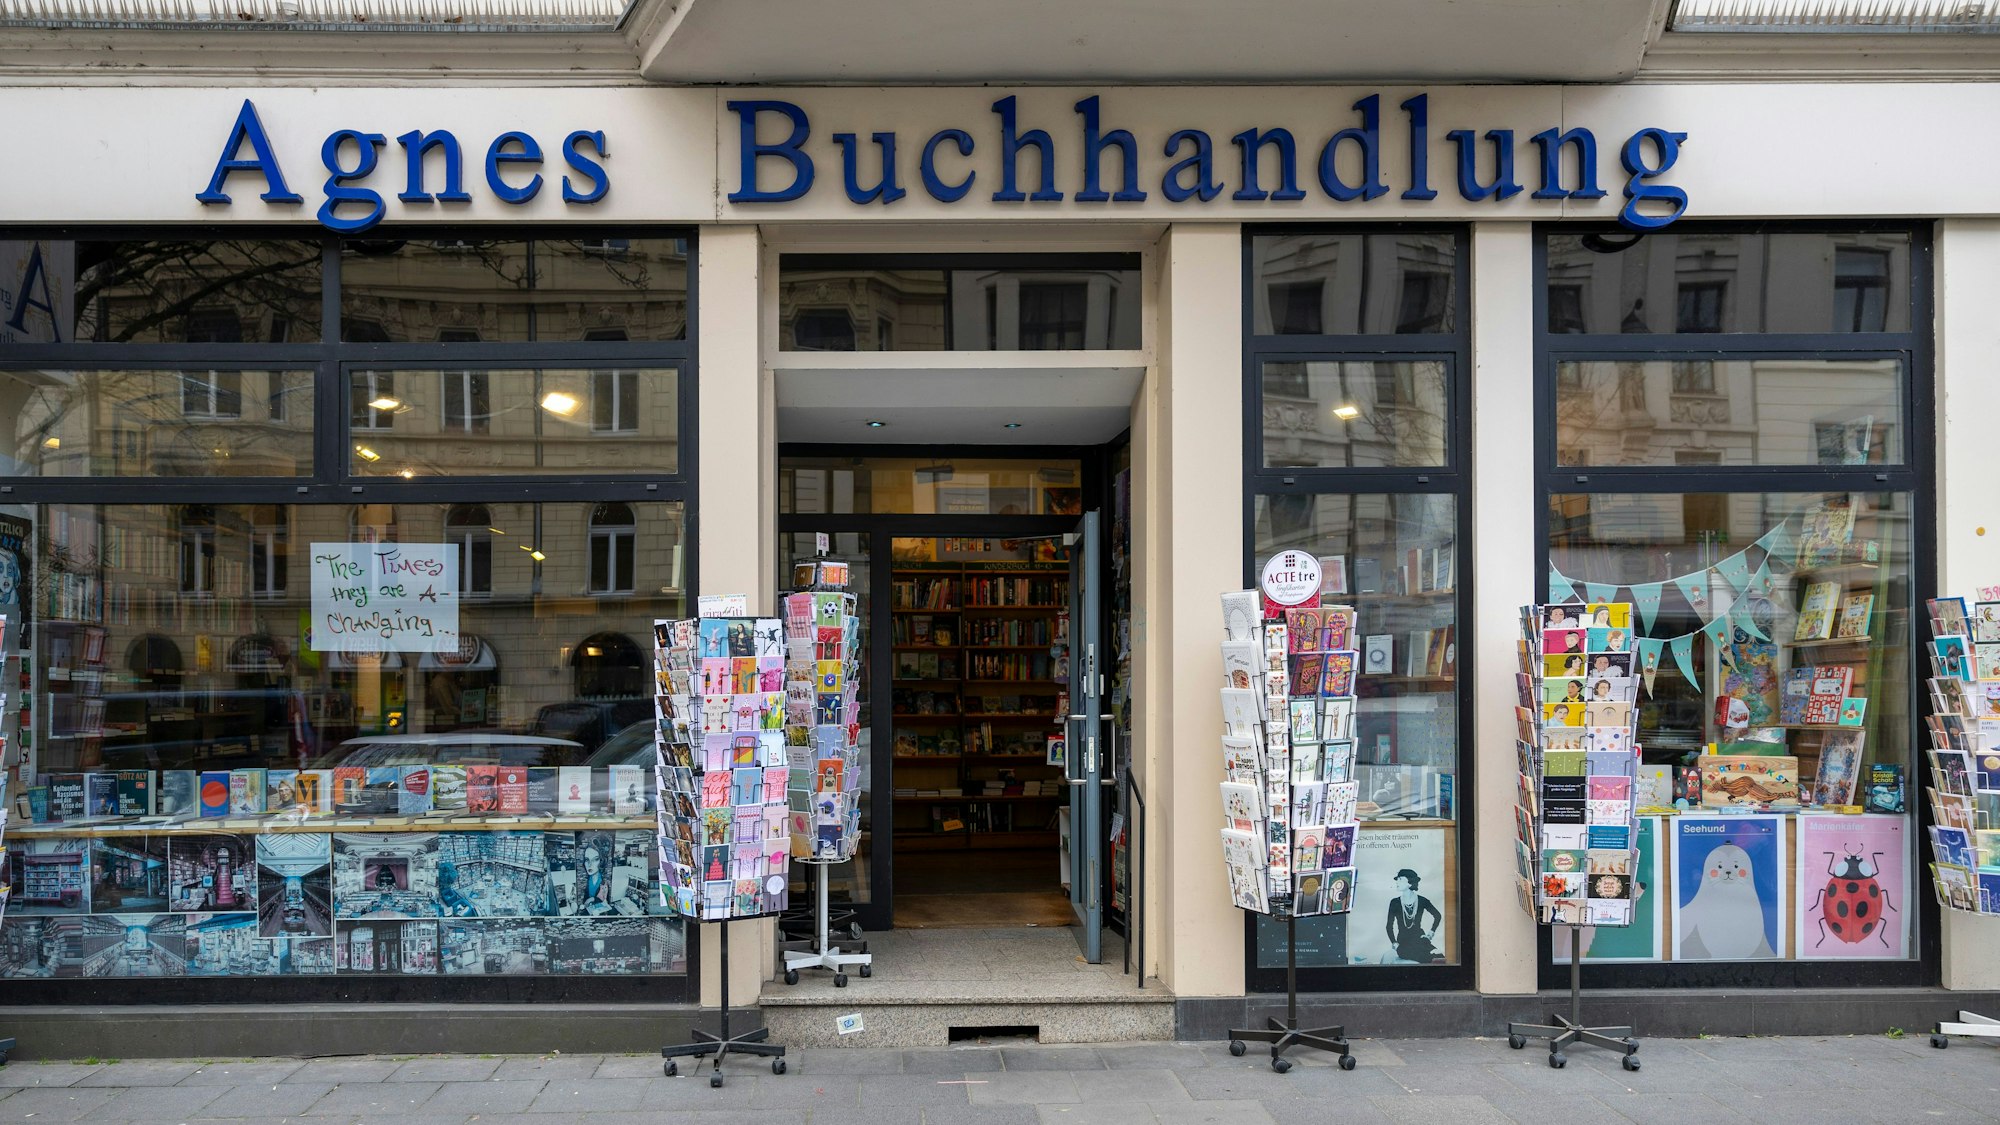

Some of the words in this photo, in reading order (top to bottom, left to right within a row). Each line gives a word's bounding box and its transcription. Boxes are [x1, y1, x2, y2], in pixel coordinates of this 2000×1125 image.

[196, 98, 610, 234] Agnes
[727, 93, 1688, 231] Buchhandlung
[315, 554, 365, 580] The
[331, 585, 368, 608] they
[380, 584, 408, 598] are
[120, 772, 135, 780] GÖTZ
[136, 772, 147, 780] ALY
[705, 772, 729, 783] ich
[703, 783, 728, 795] dich
[1683, 824, 1726, 833] Seehund
[1390, 842, 1412, 850] Augen
